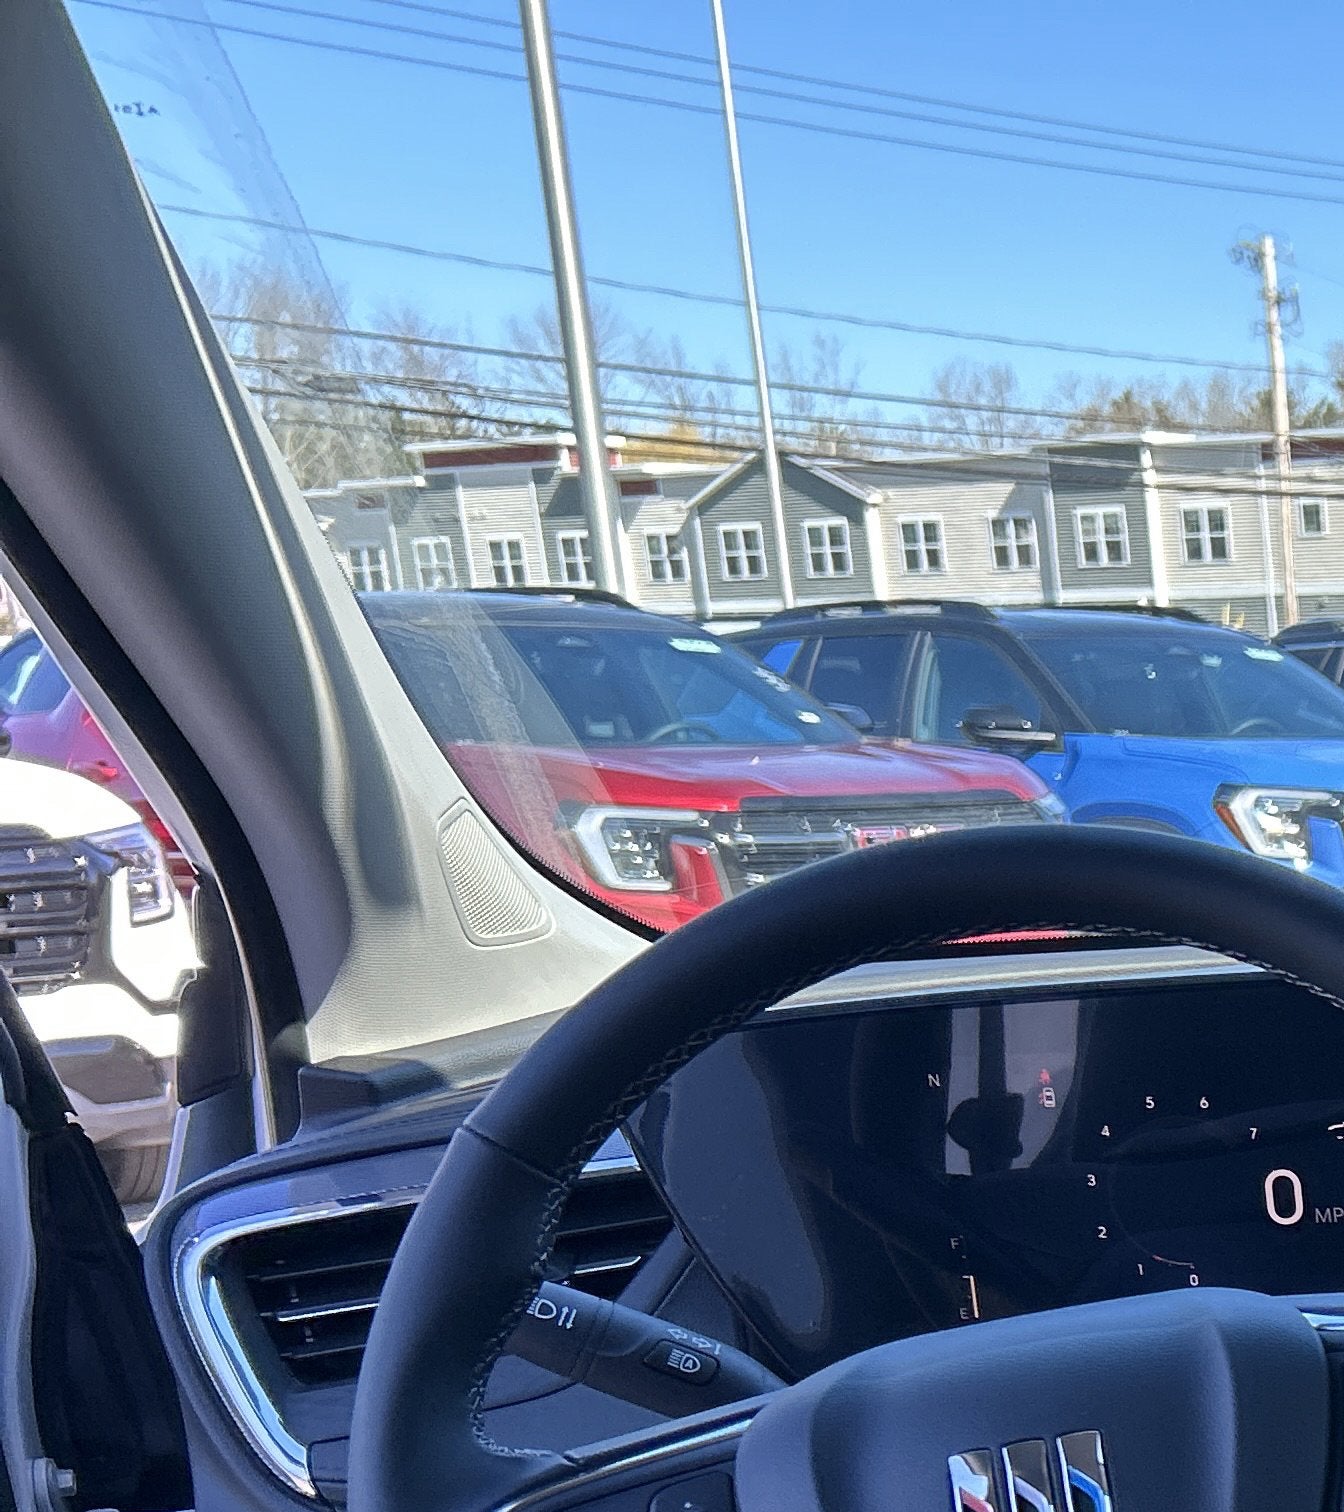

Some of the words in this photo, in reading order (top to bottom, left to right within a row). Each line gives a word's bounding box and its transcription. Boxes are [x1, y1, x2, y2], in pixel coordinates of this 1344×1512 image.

[927, 1073, 941, 1087] N
[1145, 1096, 1155, 1109] 5
[1200, 1097, 1209, 1109] 6
[1101, 1125, 1110, 1137] 4
[1250, 1128, 1258, 1140] 7
[1087, 1174, 1097, 1187] 3
[1264, 1168, 1304, 1226] 0
[1098, 1226, 1108, 1239] 2
[950, 1237, 960, 1250] F
[1189, 1274, 1199, 1287] 0
